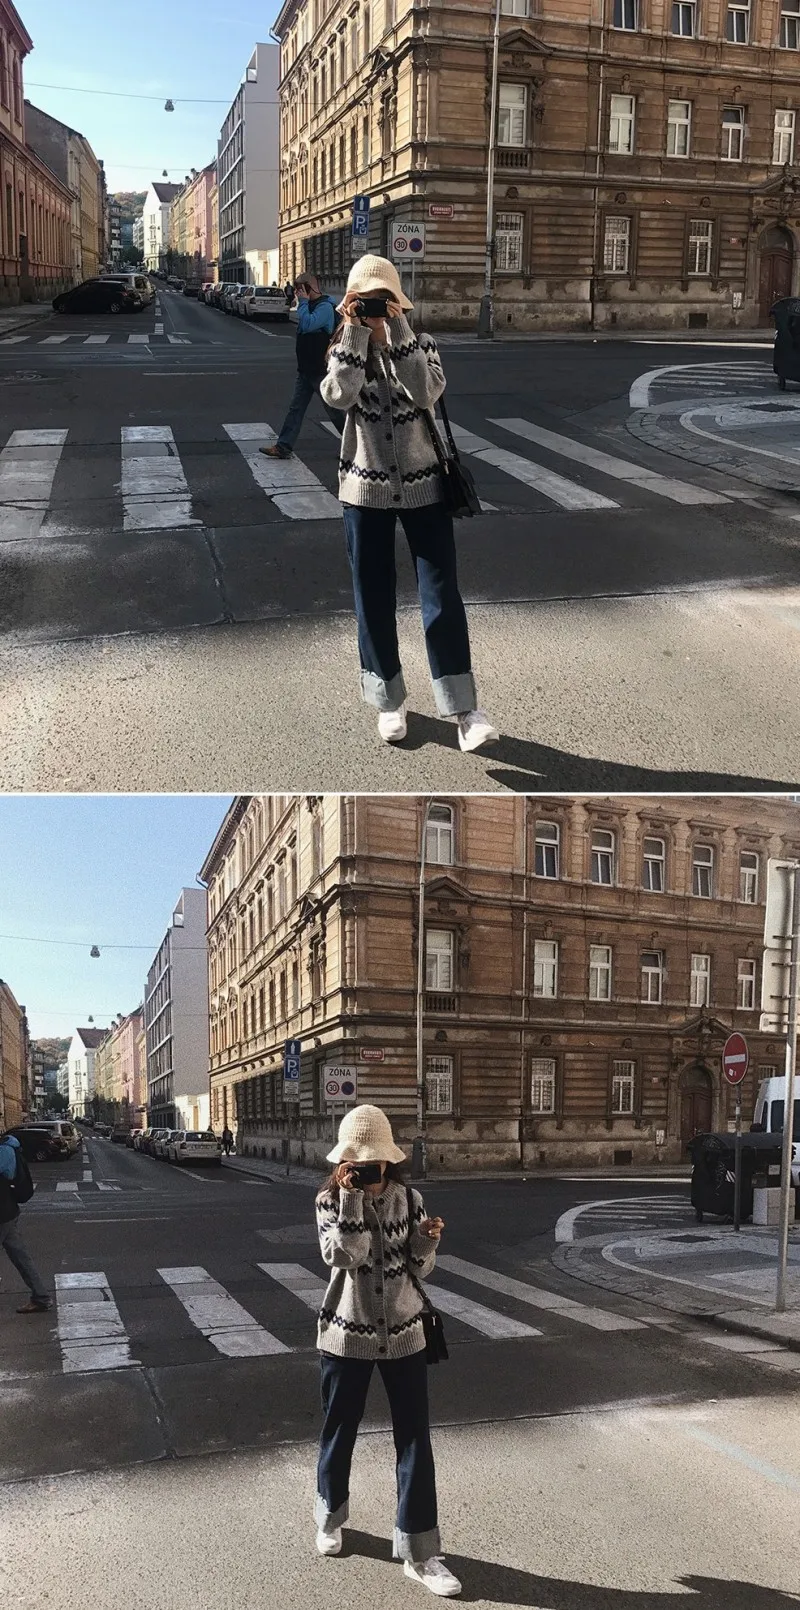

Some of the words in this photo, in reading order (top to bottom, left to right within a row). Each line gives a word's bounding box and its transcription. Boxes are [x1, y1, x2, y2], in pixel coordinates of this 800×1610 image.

[356, 215, 365, 229] P
[397, 224, 419, 233] ZÓNA
[397, 241, 405, 249] 30
[287, 1060, 297, 1072] P
[329, 1067, 351, 1076] ZÓNA
